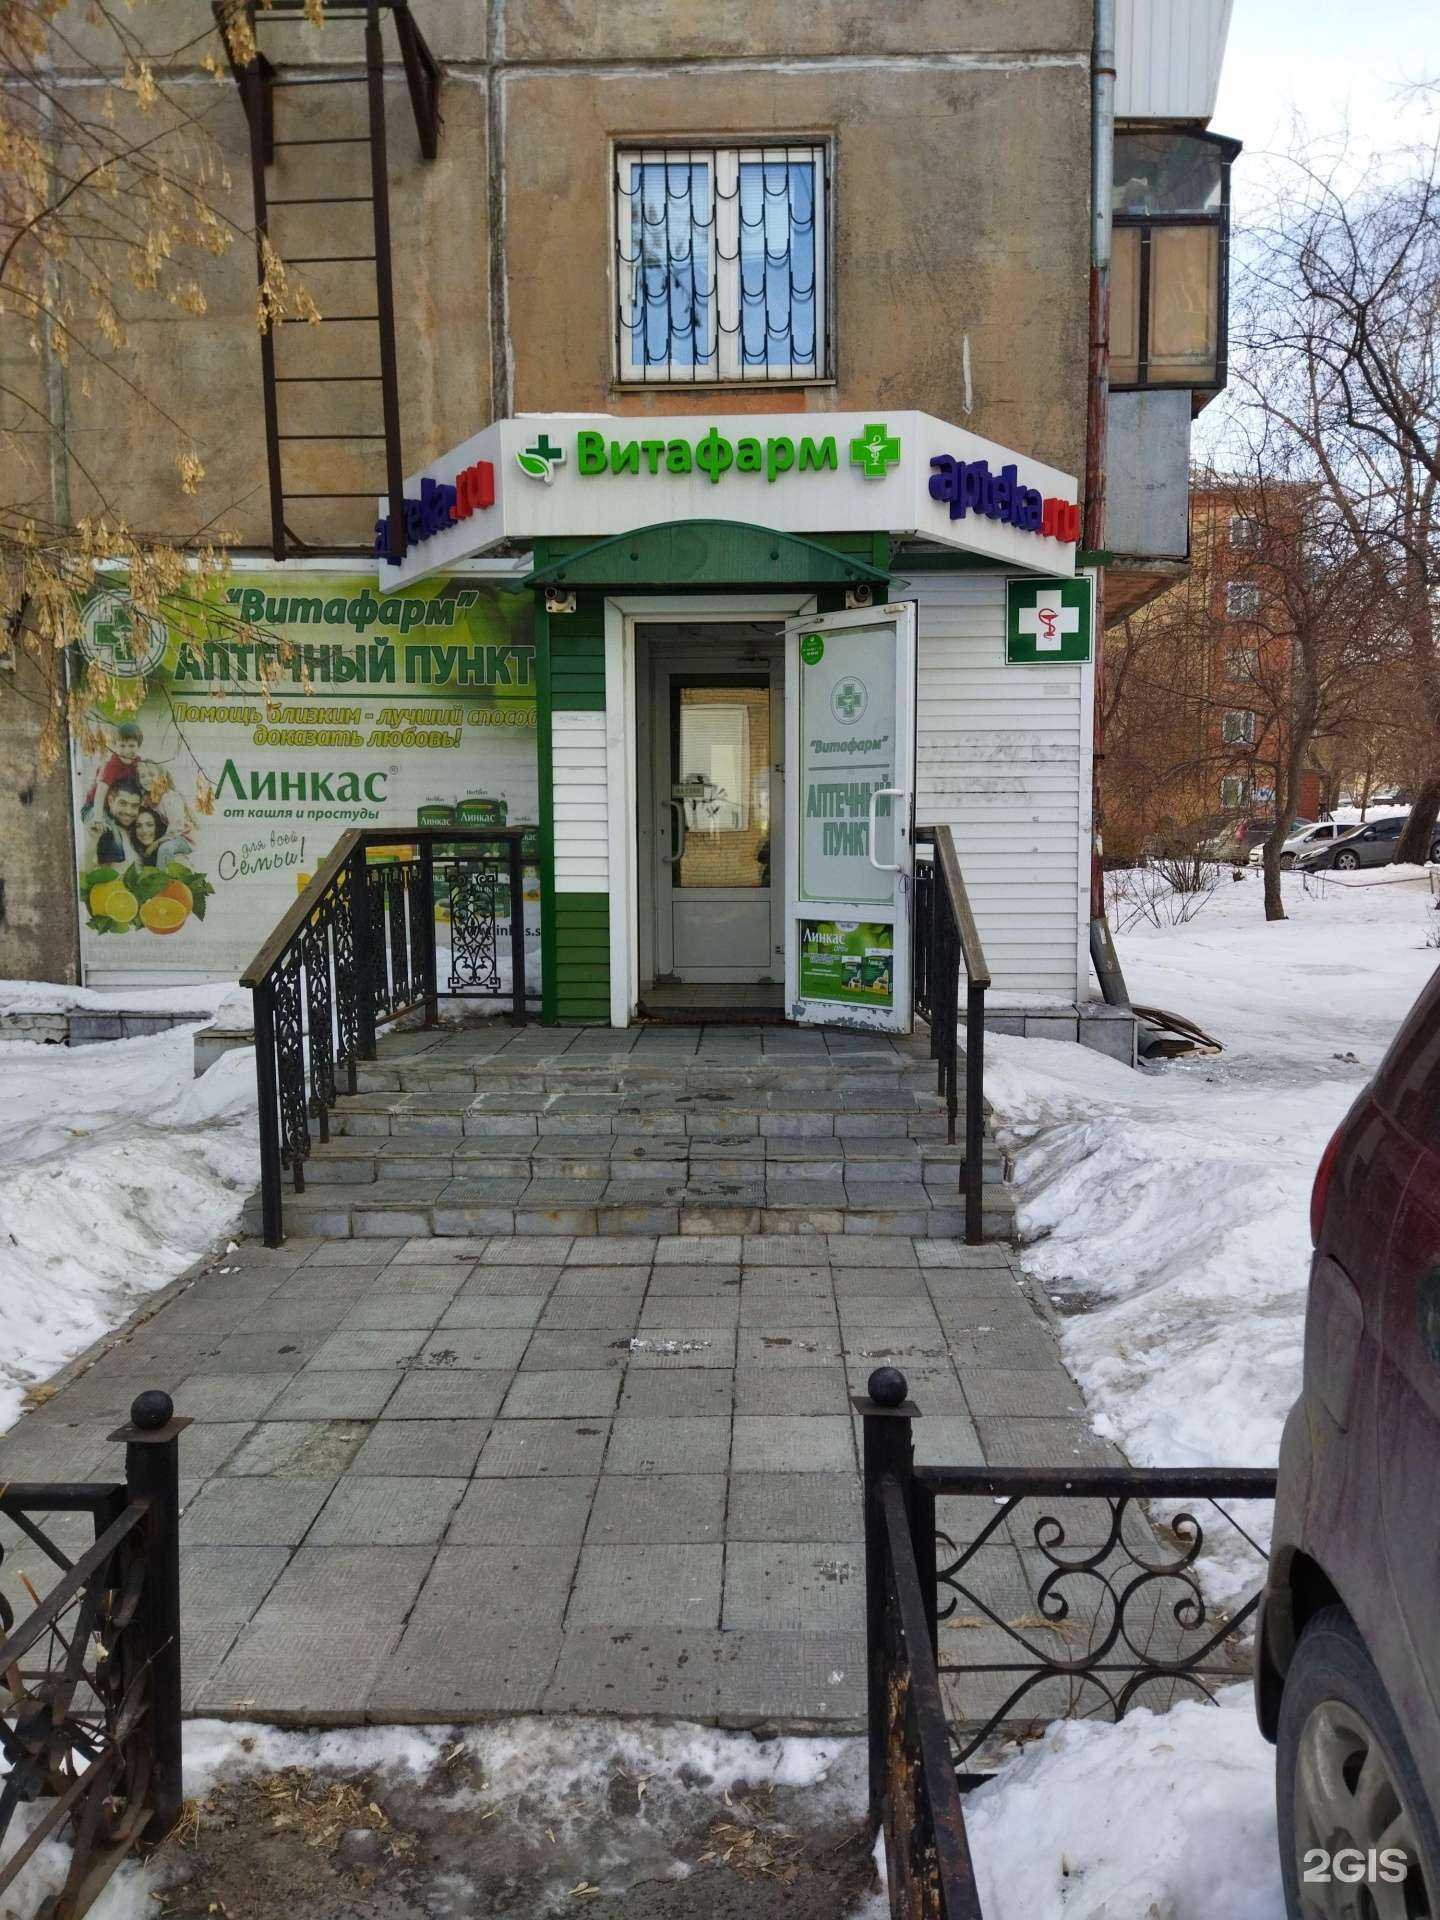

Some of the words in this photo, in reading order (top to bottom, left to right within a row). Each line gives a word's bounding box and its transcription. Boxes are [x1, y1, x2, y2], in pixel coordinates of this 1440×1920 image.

[577, 427, 839, 484] Витафарм
[375, 460, 494, 566] aeka.ru
[405, 645, 537, 686] ПУНКТ
[172, 702, 262, 726] Помощь
[267, 703, 361, 725] близким
[376, 704, 464, 728] лучший
[253, 724, 364, 747] доказать
[367, 727, 463, 748] любовь!
[214, 758, 388, 802] Линкас
[224, 809, 244, 818] от
[248, 808, 292, 818] кашля
[296, 809, 304, 818] и
[307, 808, 380, 821] простуды
